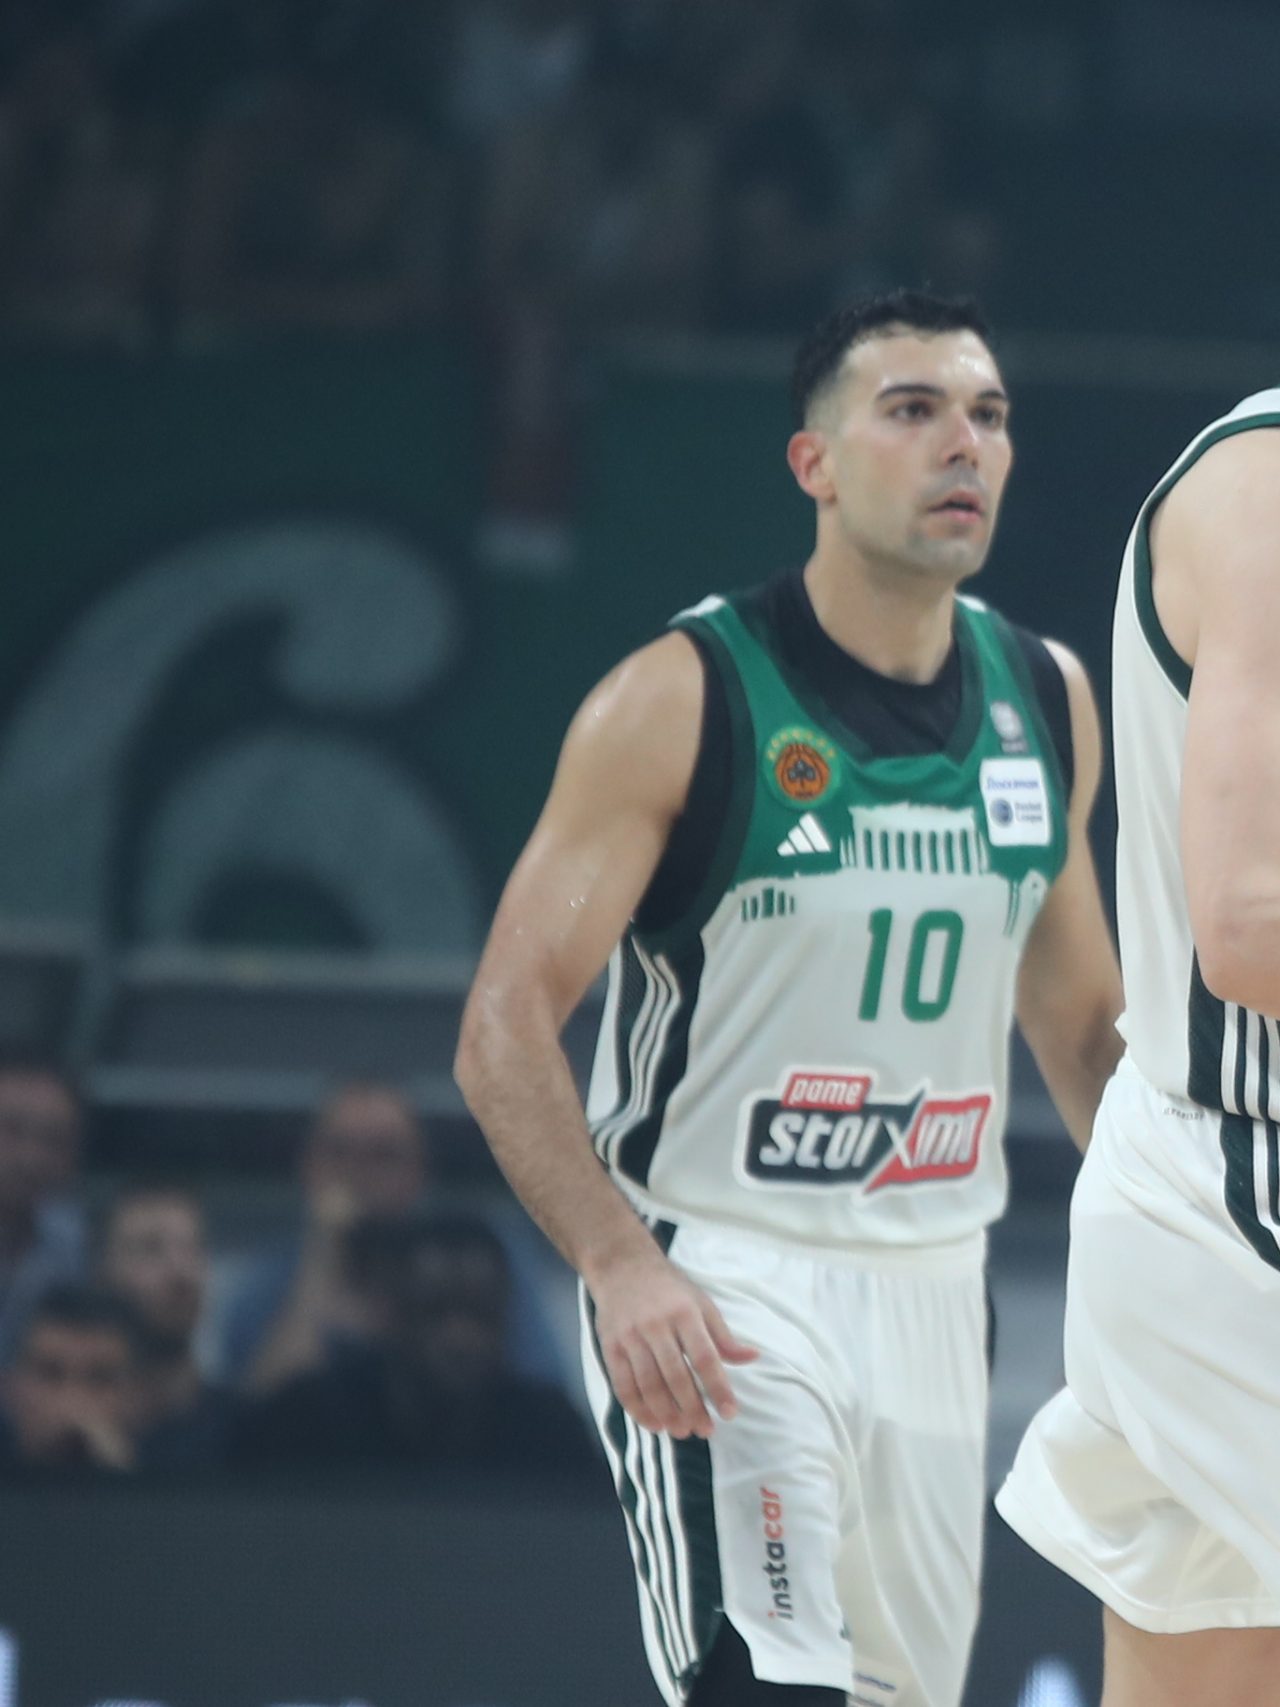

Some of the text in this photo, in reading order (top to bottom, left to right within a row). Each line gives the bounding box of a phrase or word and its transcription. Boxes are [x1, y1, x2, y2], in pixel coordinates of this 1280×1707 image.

[858, 908, 964, 1022] 10
[788, 1077, 864, 1106] pame
[760, 1485, 793, 1621] instacar
